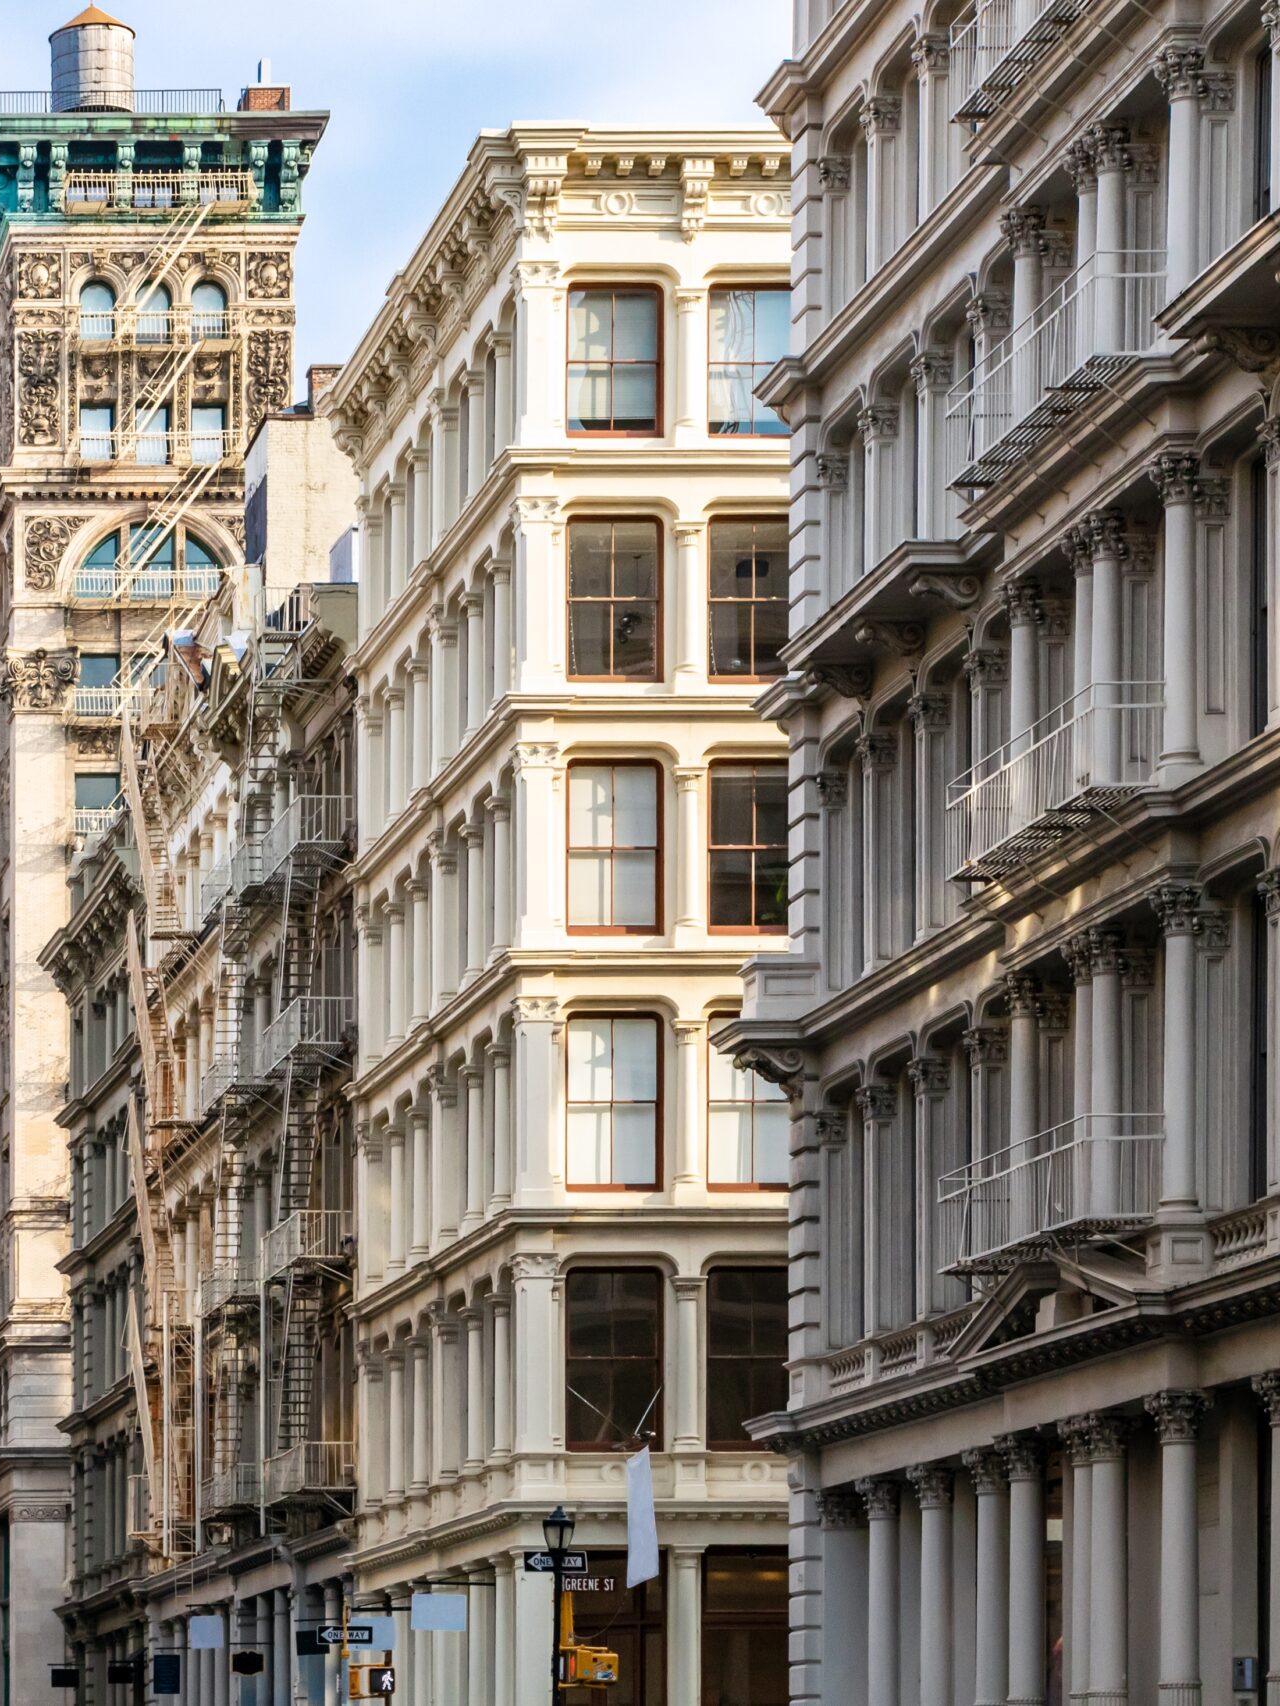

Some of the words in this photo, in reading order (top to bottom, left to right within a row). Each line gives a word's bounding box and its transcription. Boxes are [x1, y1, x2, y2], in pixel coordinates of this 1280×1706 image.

[533, 1557, 553, 1566] ONE
[565, 1578, 600, 1591] GREENE
[603, 1578, 615, 1591] ST
[327, 1631, 344, 1639] ONE
[348, 1631, 366, 1639] WAY
